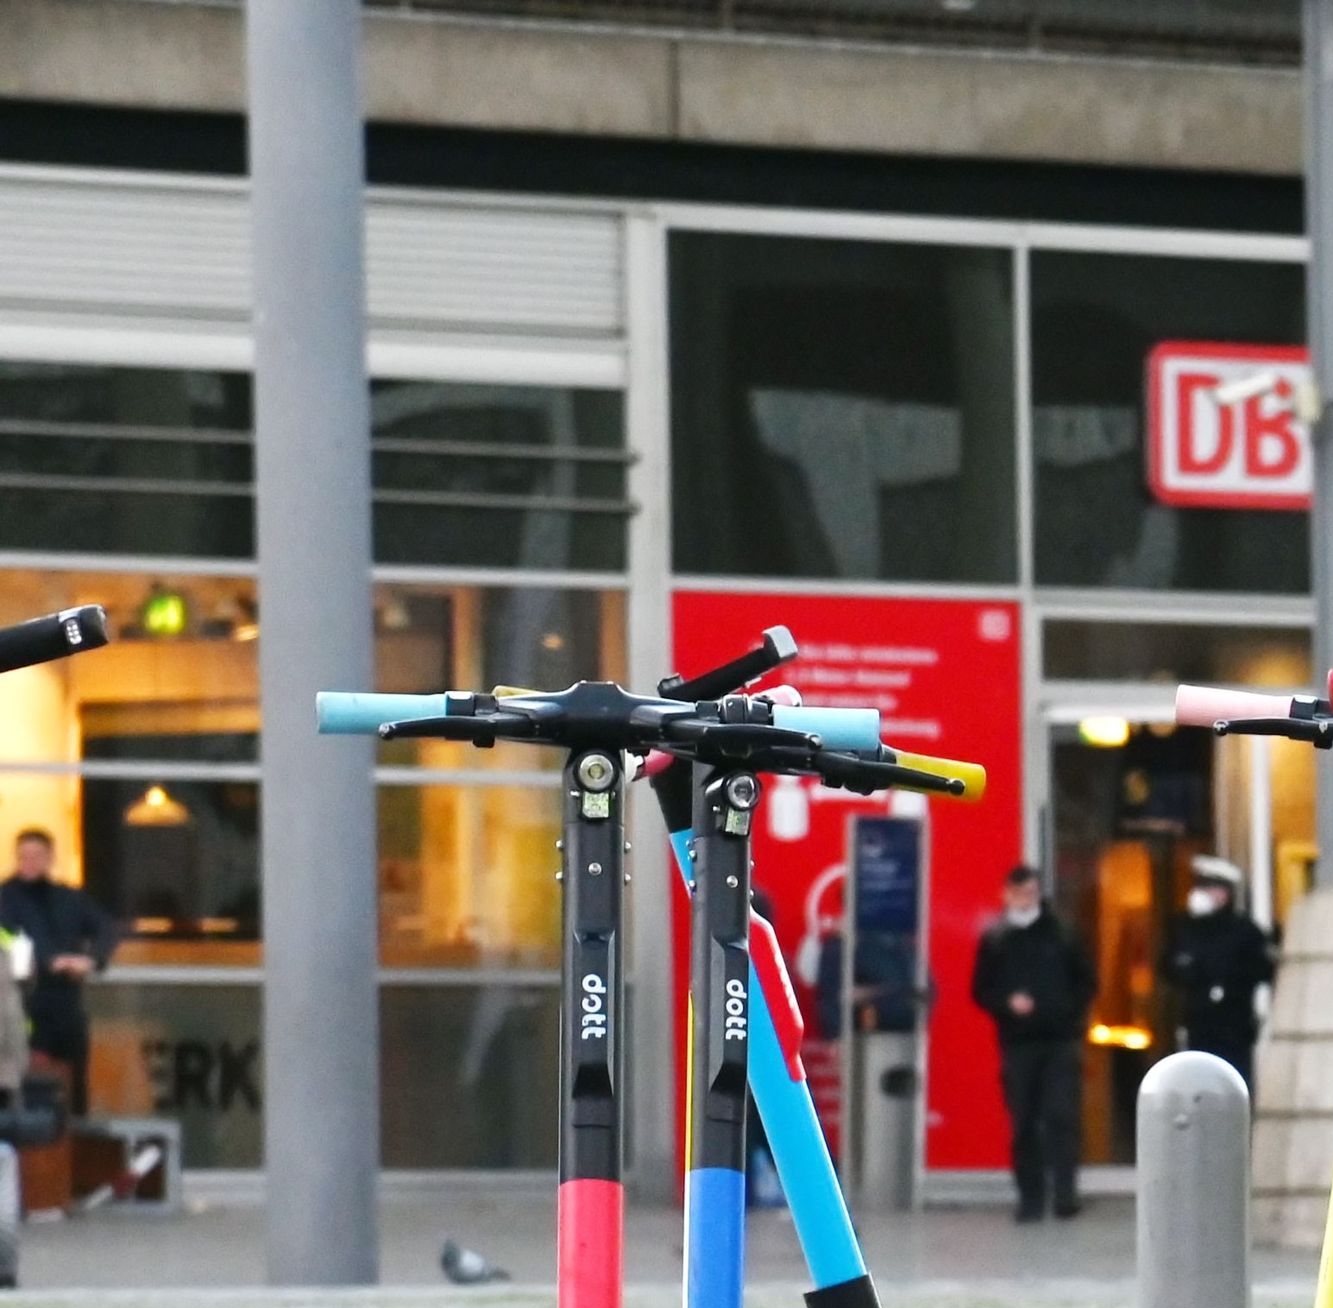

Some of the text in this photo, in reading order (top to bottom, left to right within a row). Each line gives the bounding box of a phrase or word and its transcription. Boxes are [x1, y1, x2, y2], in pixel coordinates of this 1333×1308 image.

[1177, 373, 1301, 479] DB
[581, 974, 607, 1040] dott
[725, 979, 747, 1040] dott
